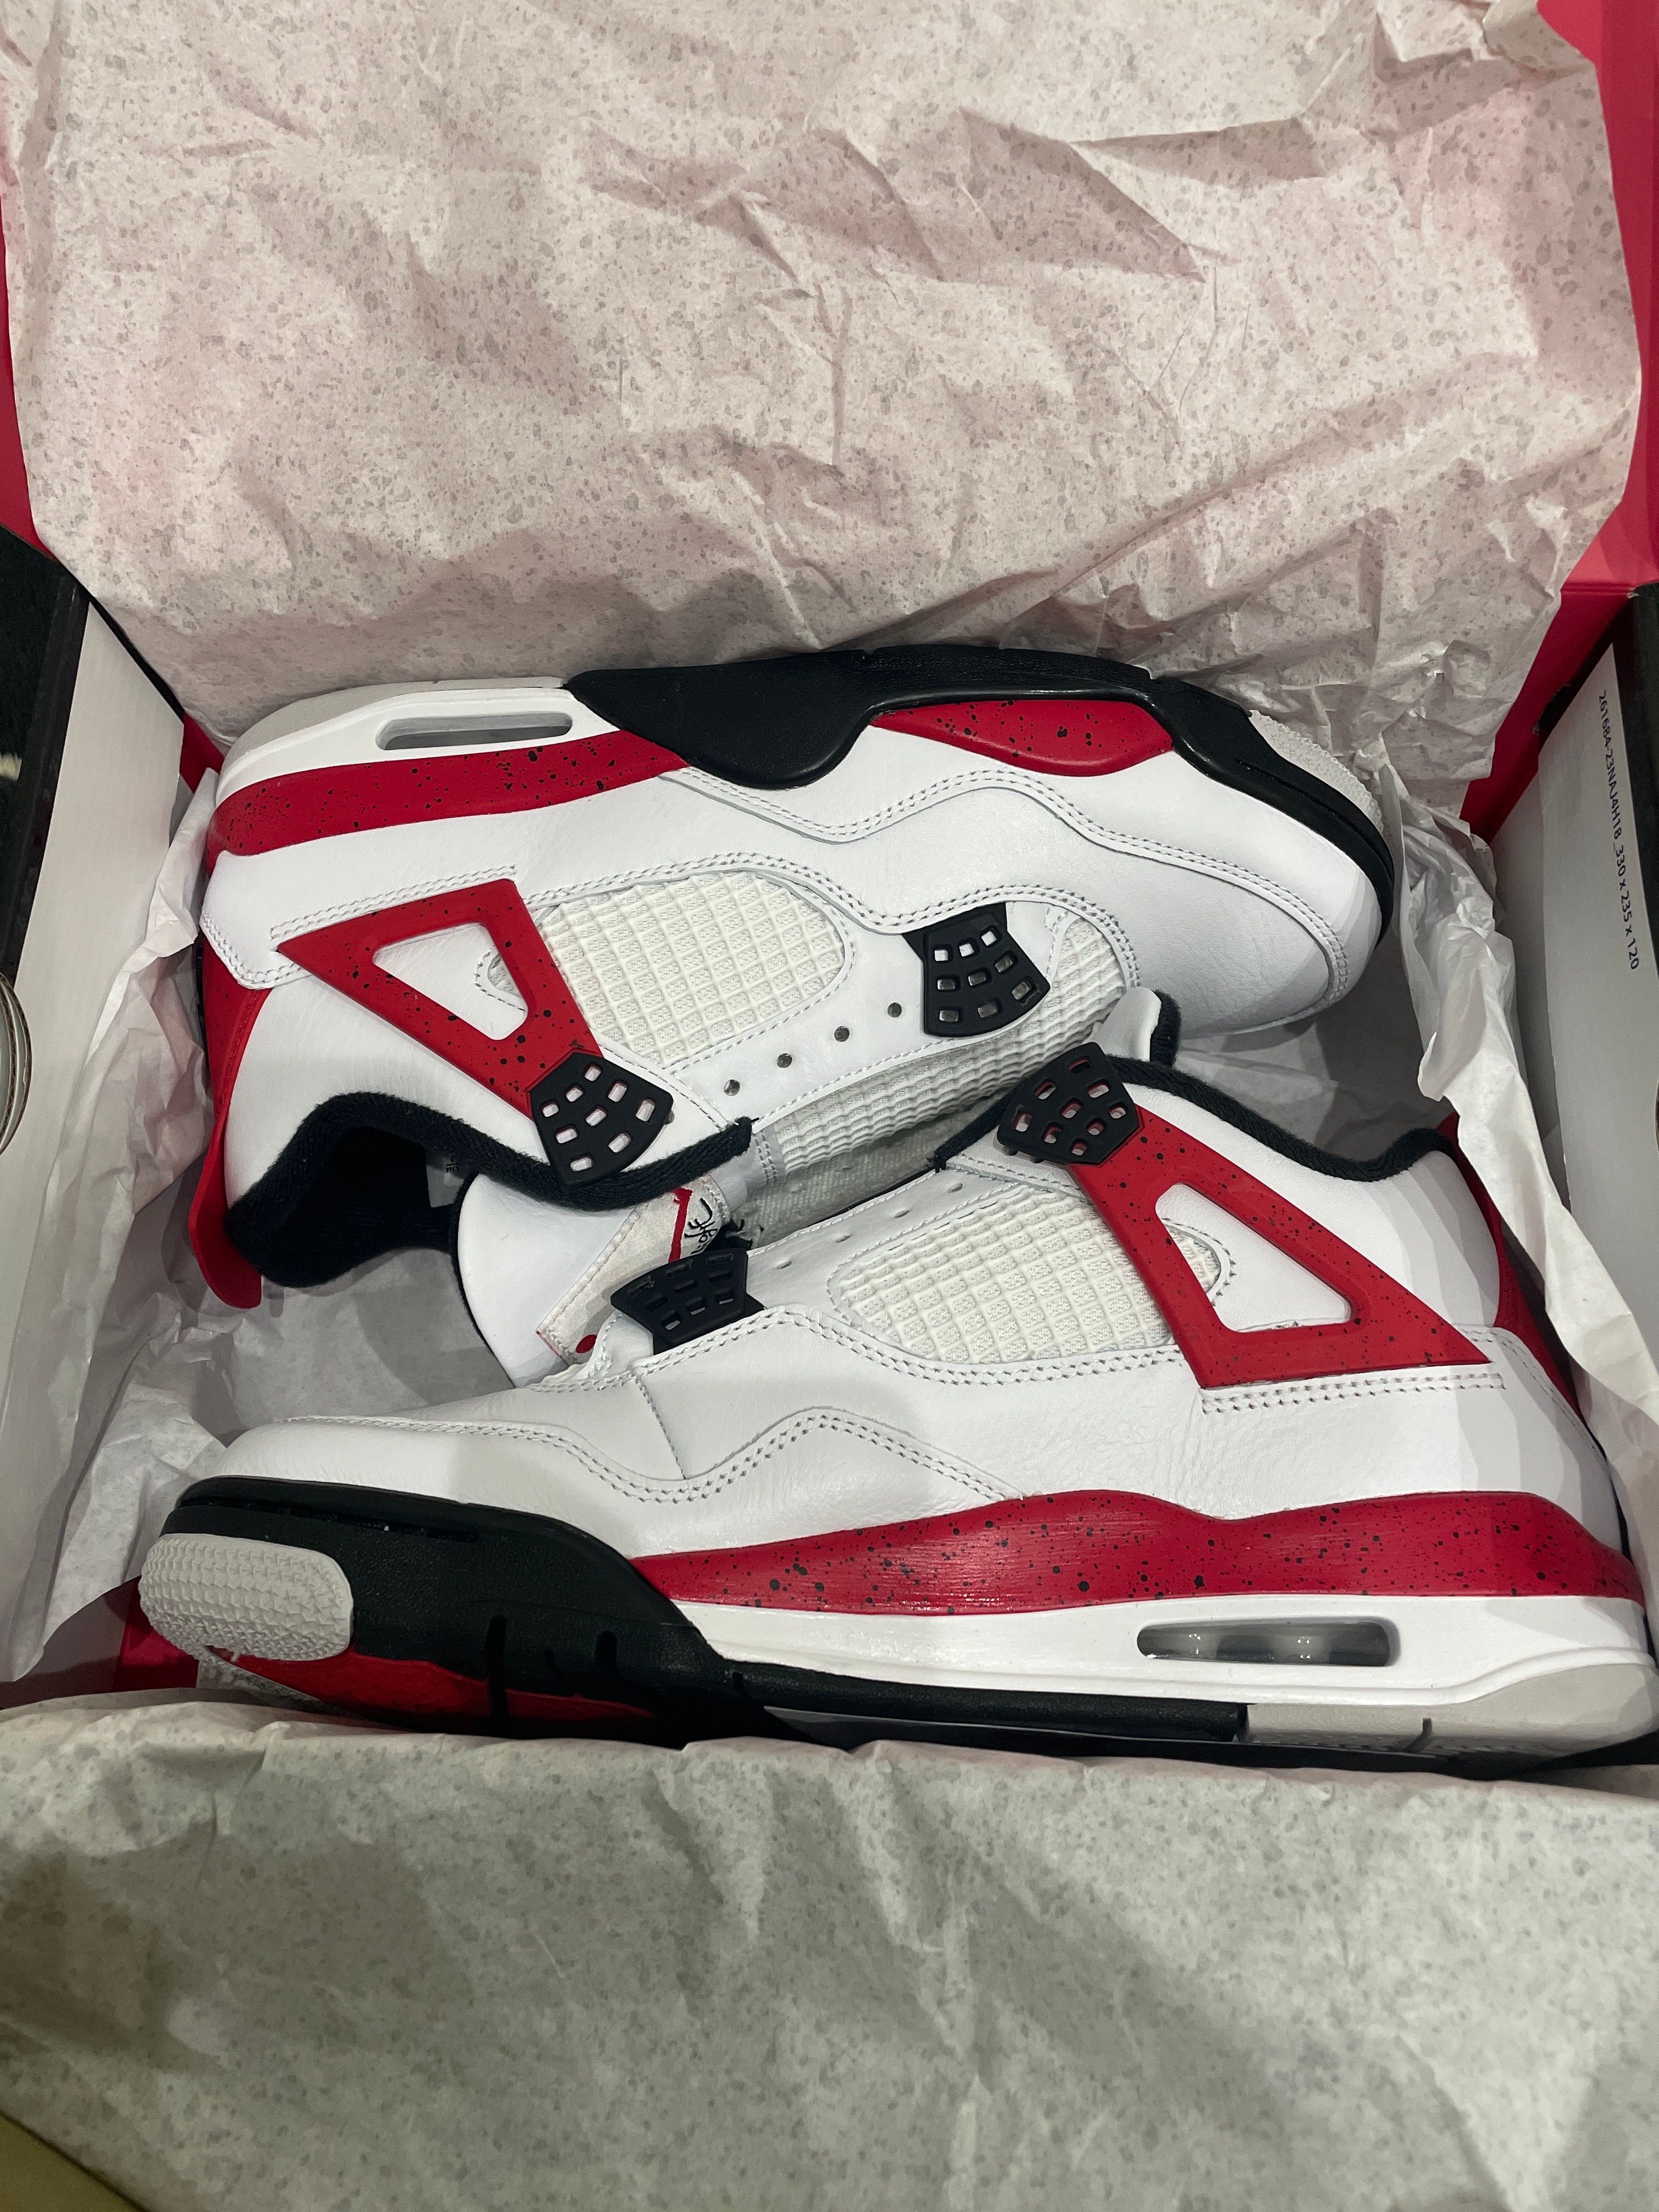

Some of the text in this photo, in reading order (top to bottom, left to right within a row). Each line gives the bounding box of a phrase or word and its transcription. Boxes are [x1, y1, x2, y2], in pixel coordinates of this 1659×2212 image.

[1620, 879, 1626, 890] x
[1621, 890, 1632, 923] 235
[1625, 924, 1633, 937] x
[1628, 938, 1639, 970] 120
